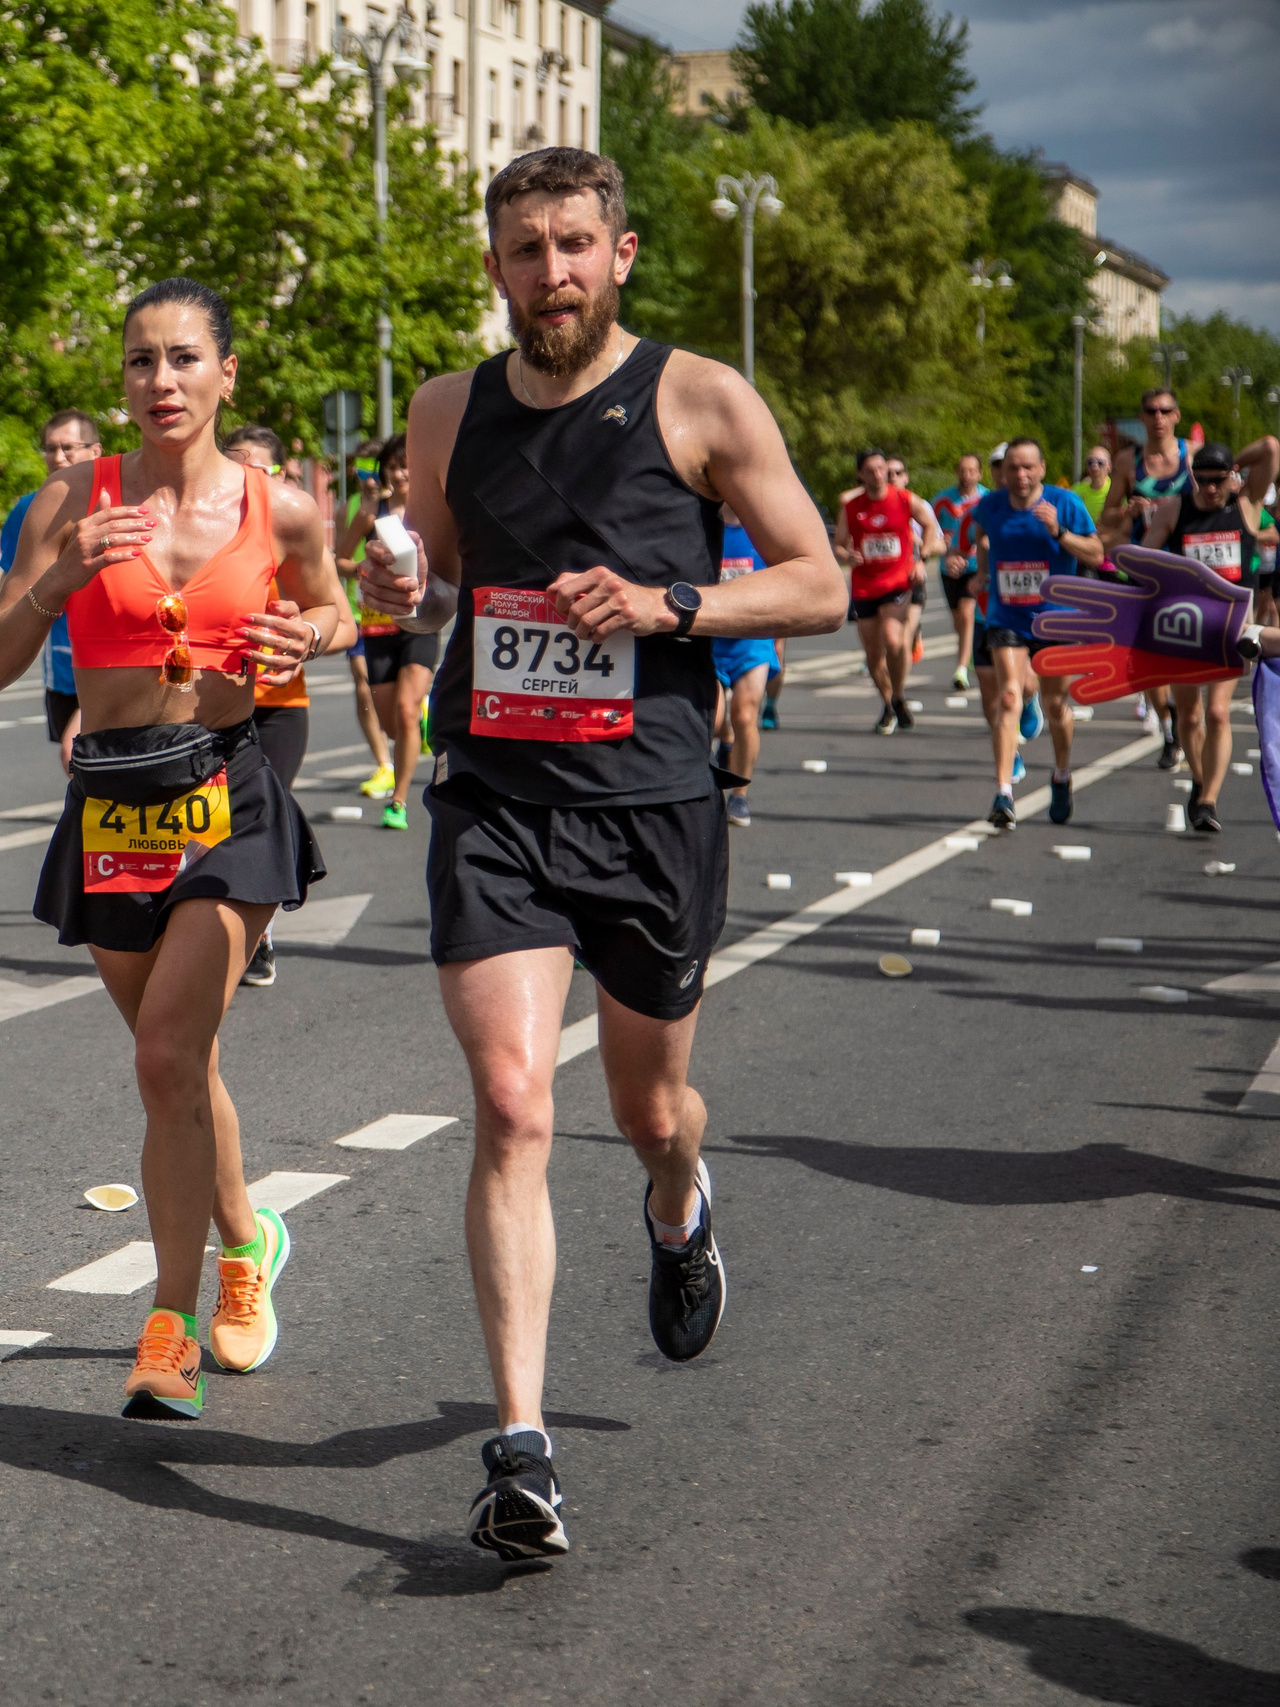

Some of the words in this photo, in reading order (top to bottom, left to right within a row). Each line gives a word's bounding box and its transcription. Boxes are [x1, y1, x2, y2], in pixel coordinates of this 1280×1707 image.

[490, 591, 545, 604] МОСКОВСКИЙ
[491, 625, 614, 677] 8734
[522, 678, 579, 694] СЕРГЕЙ
[99, 794, 211, 835] 4140
[128, 839, 186, 850] ЛЮБОВЬ
